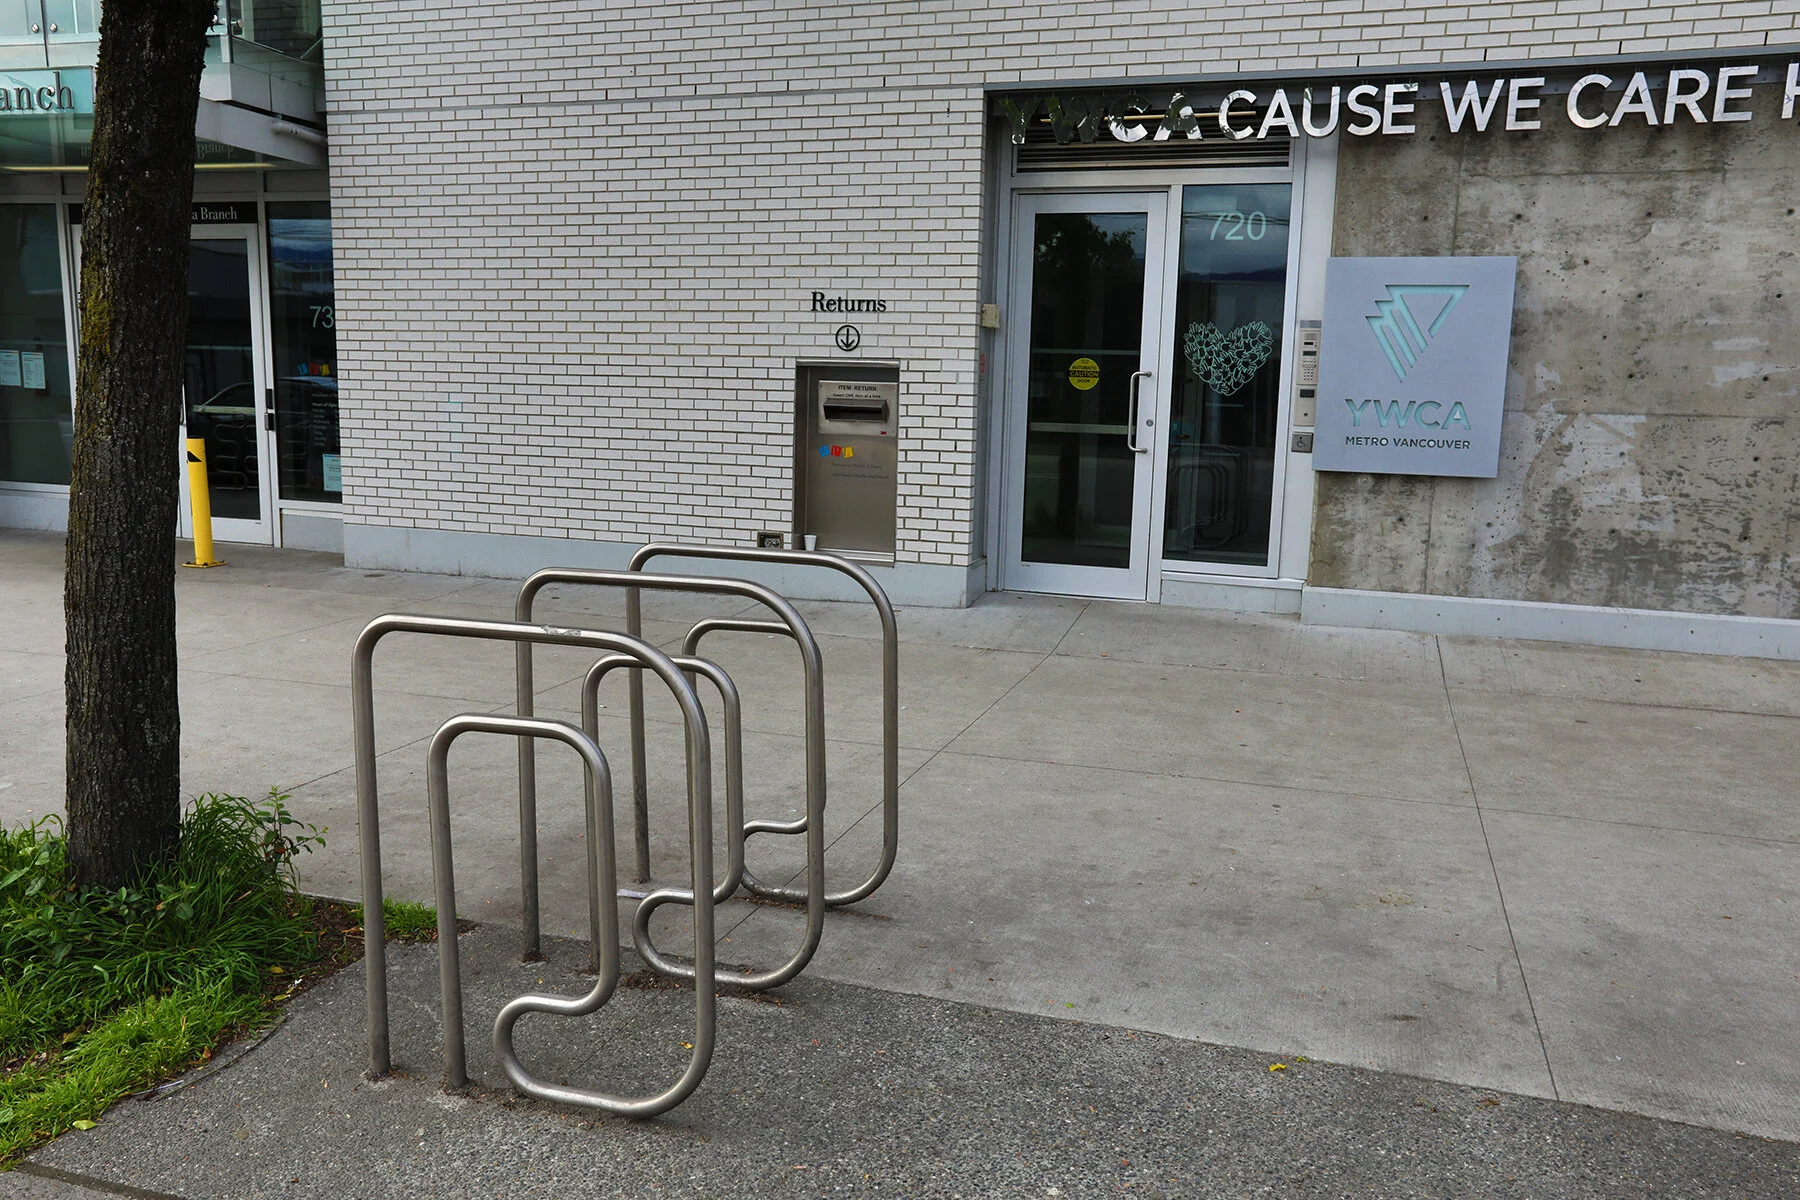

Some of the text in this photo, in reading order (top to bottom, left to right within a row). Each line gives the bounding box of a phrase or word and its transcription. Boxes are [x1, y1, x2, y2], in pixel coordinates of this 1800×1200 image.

[998, 91, 1204, 145] YWCA
[1218, 82, 1418, 141] CAUSE
[1439, 76, 1546, 133] WE
[1567, 64, 1759, 129] CARE
[200, 206, 238, 221] Branch
[1208, 211, 1267, 240] 720
[811, 291, 887, 313] Returns
[309, 305, 334, 328] 73
[1345, 398, 1471, 431] YWCA
[1345, 436, 1471, 449] METRO VANCOUVER
